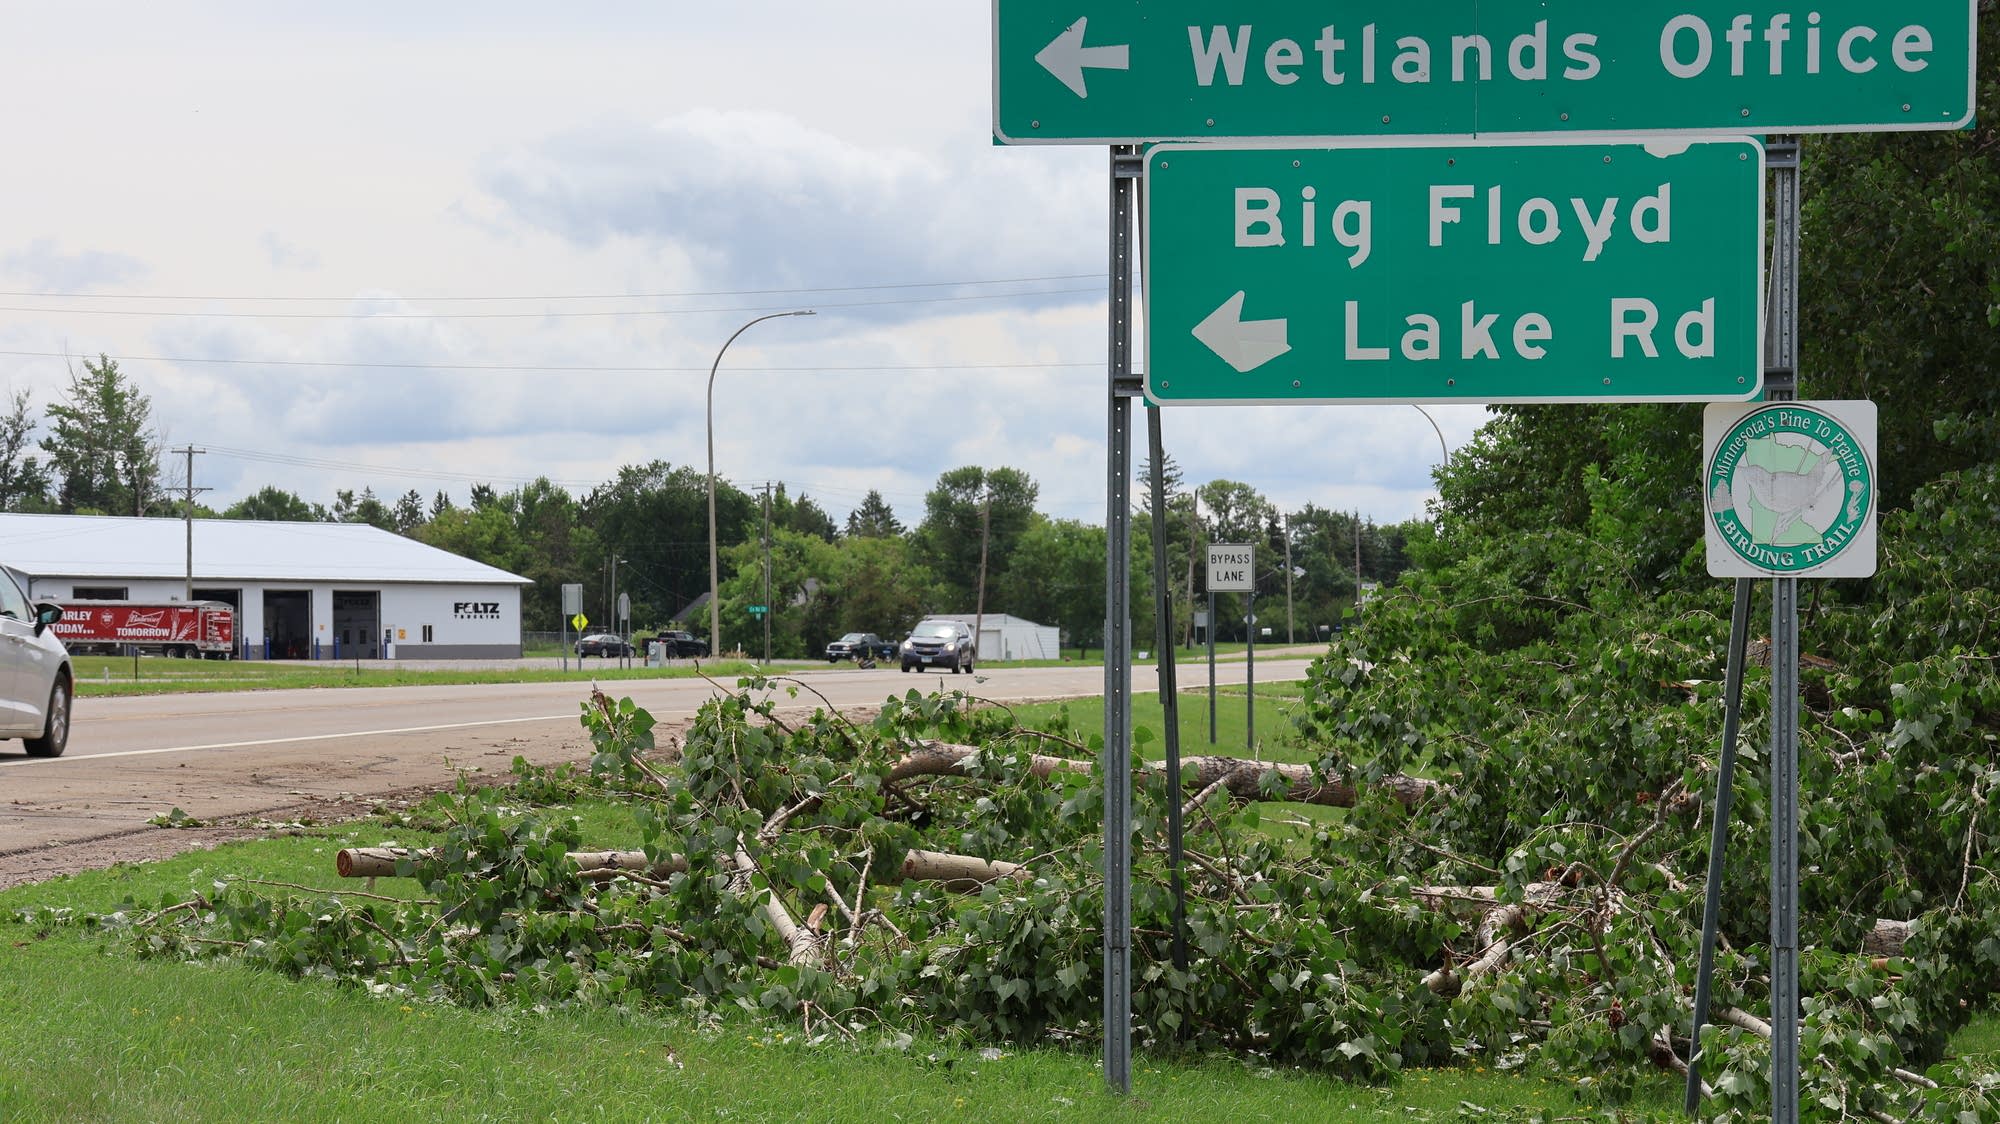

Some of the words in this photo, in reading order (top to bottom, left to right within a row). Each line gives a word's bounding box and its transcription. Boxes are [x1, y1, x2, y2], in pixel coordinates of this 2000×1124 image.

[1187, 19, 1601, 86] Wetlands
[1660, 11, 1933, 79] Office
[1234, 186, 1372, 269] Big
[1429, 182, 1671, 262] Floyd
[1345, 299, 1553, 361] Lake
[1611, 297, 1715, 359] Rd
[1715, 415, 1775, 478] Minnesota's
[1779, 411, 1811, 430] Pine
[1816, 419, 1832, 439] To
[1830, 432, 1863, 478] Prairie
[1210, 553, 1250, 565] BYPASS
[1723, 520, 1795, 567] BIRDING
[1801, 523, 1855, 563] TRAIL
[1216, 571, 1245, 582] LANE
[60, 611, 92, 621] ARLEY
[116, 627, 170, 637] TOMORROW
